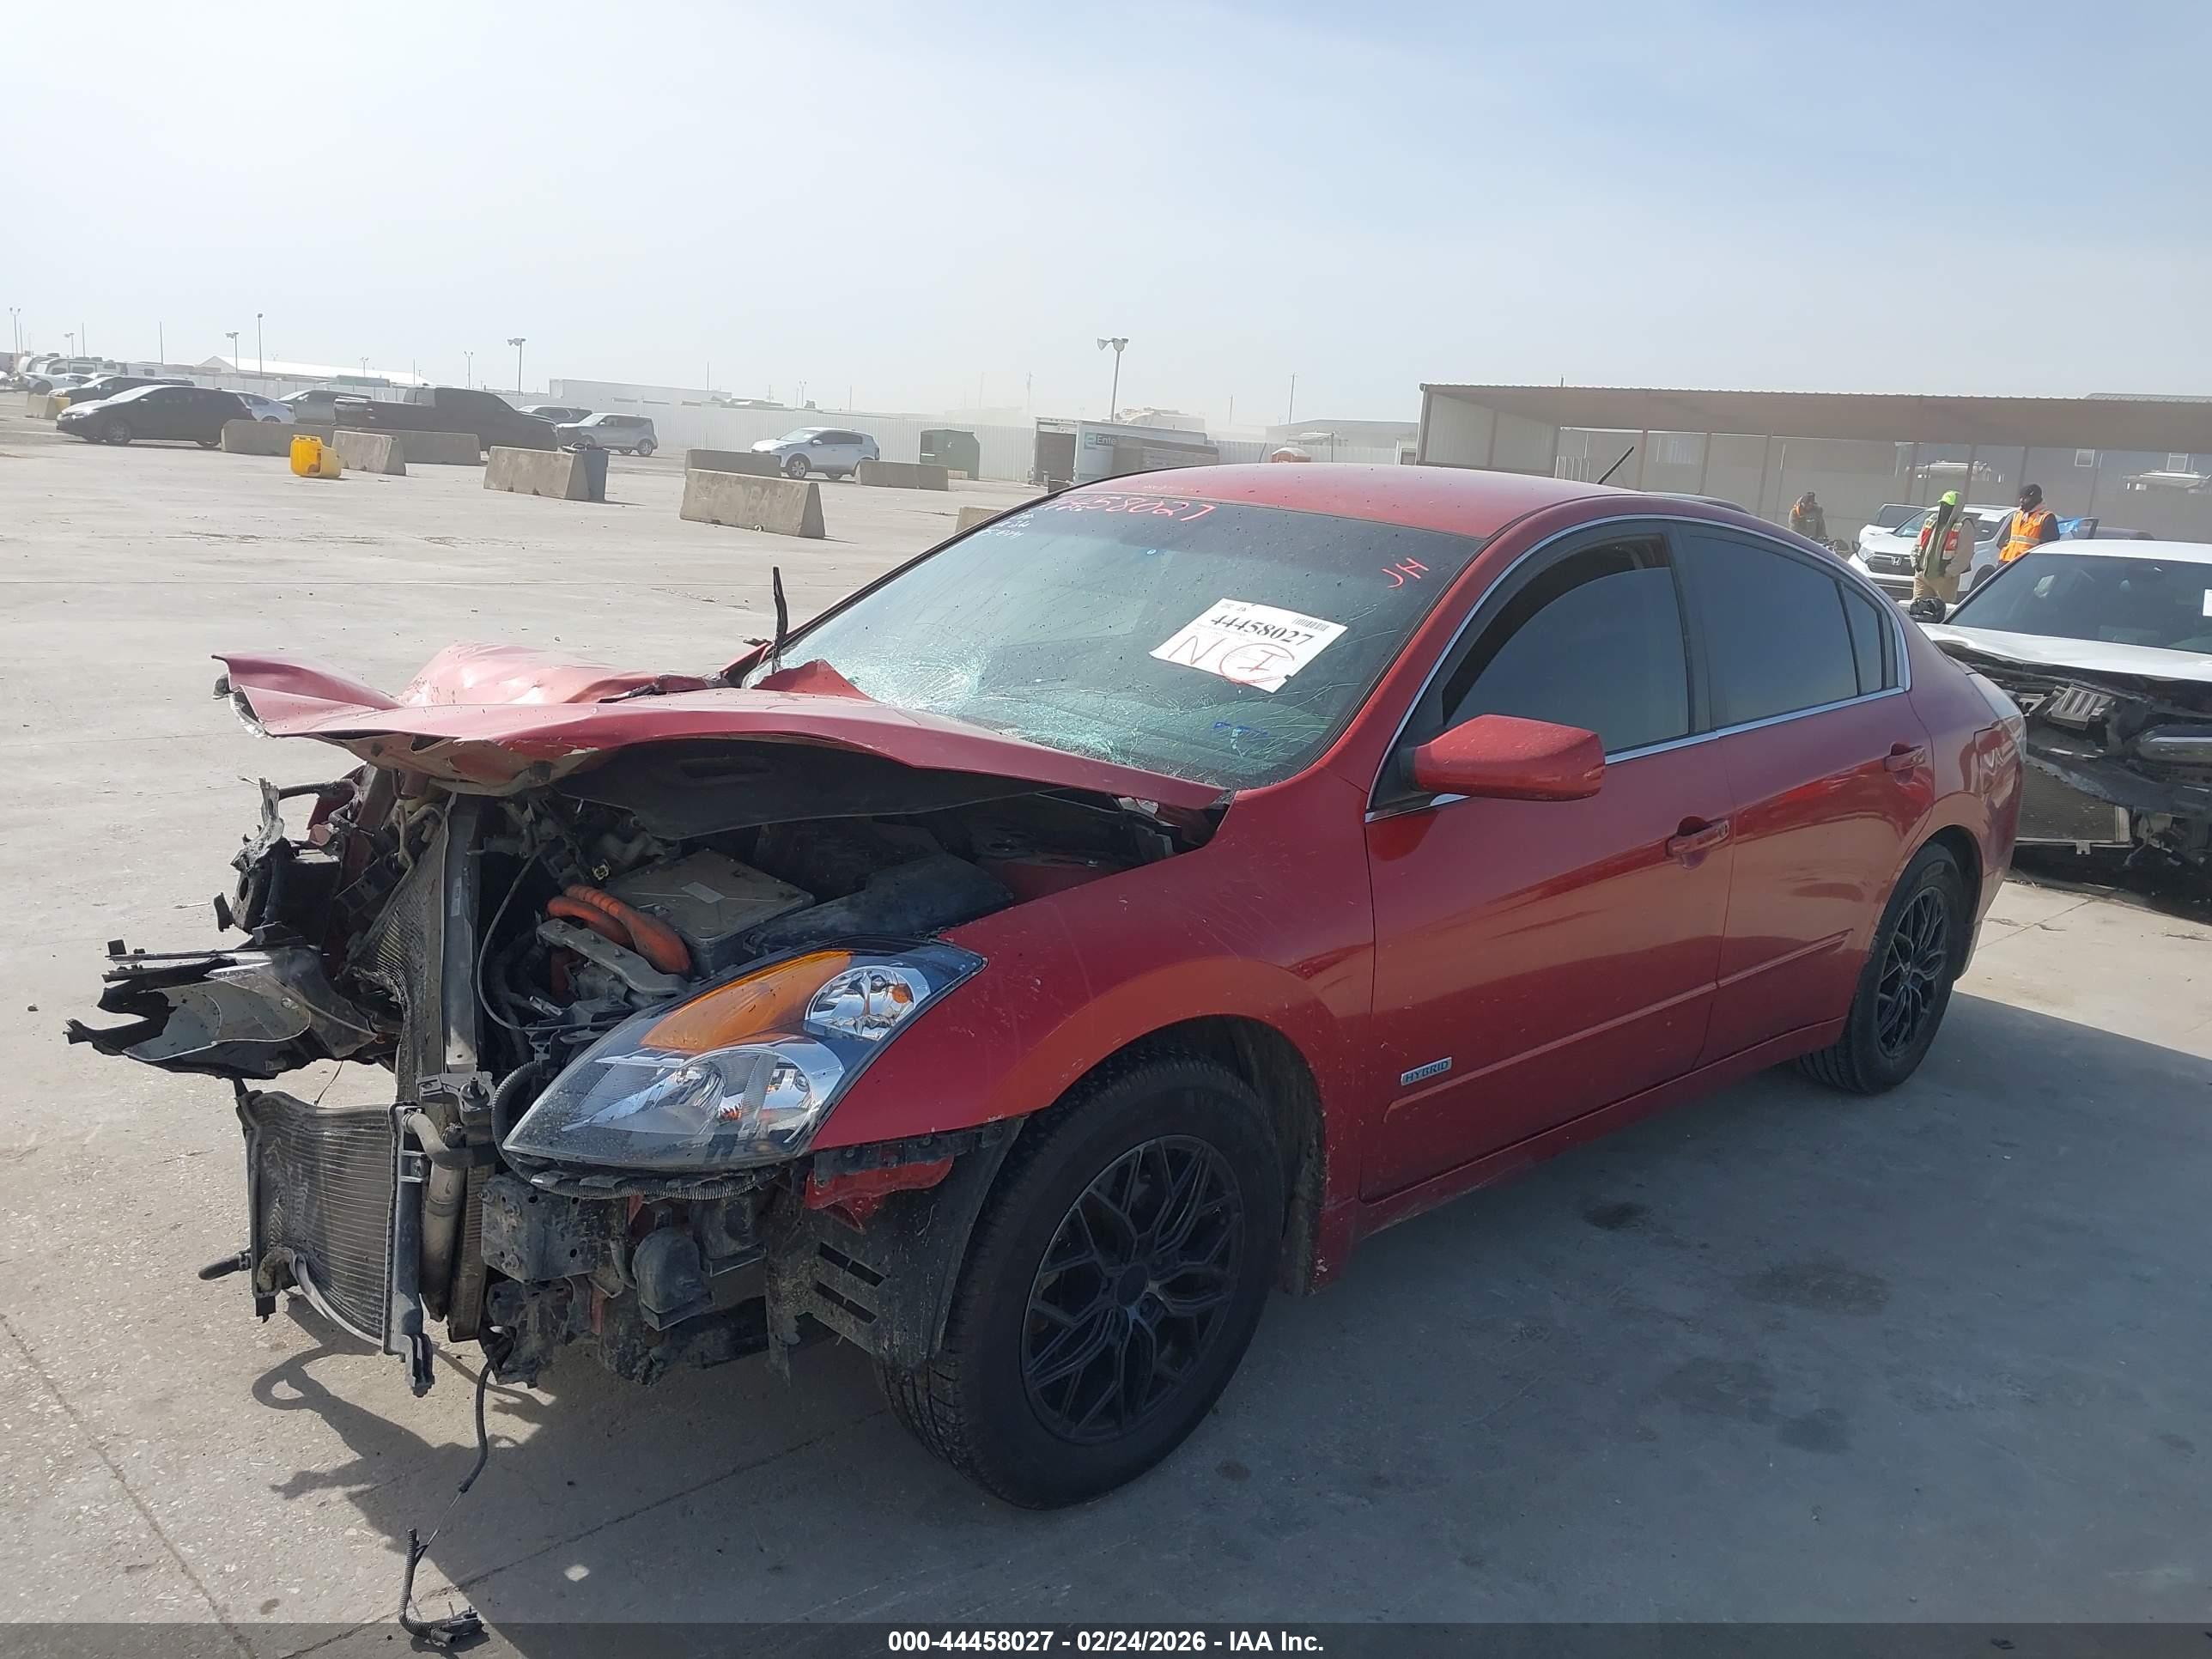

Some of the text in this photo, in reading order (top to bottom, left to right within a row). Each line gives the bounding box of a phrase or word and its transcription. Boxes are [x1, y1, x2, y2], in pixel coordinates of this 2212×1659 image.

[1380, 556, 1430, 588] JH
[1211, 614, 1315, 647] 44458027
[1168, 635, 1228, 665] N
[1405, 1060, 1449, 1083] HYBRID
